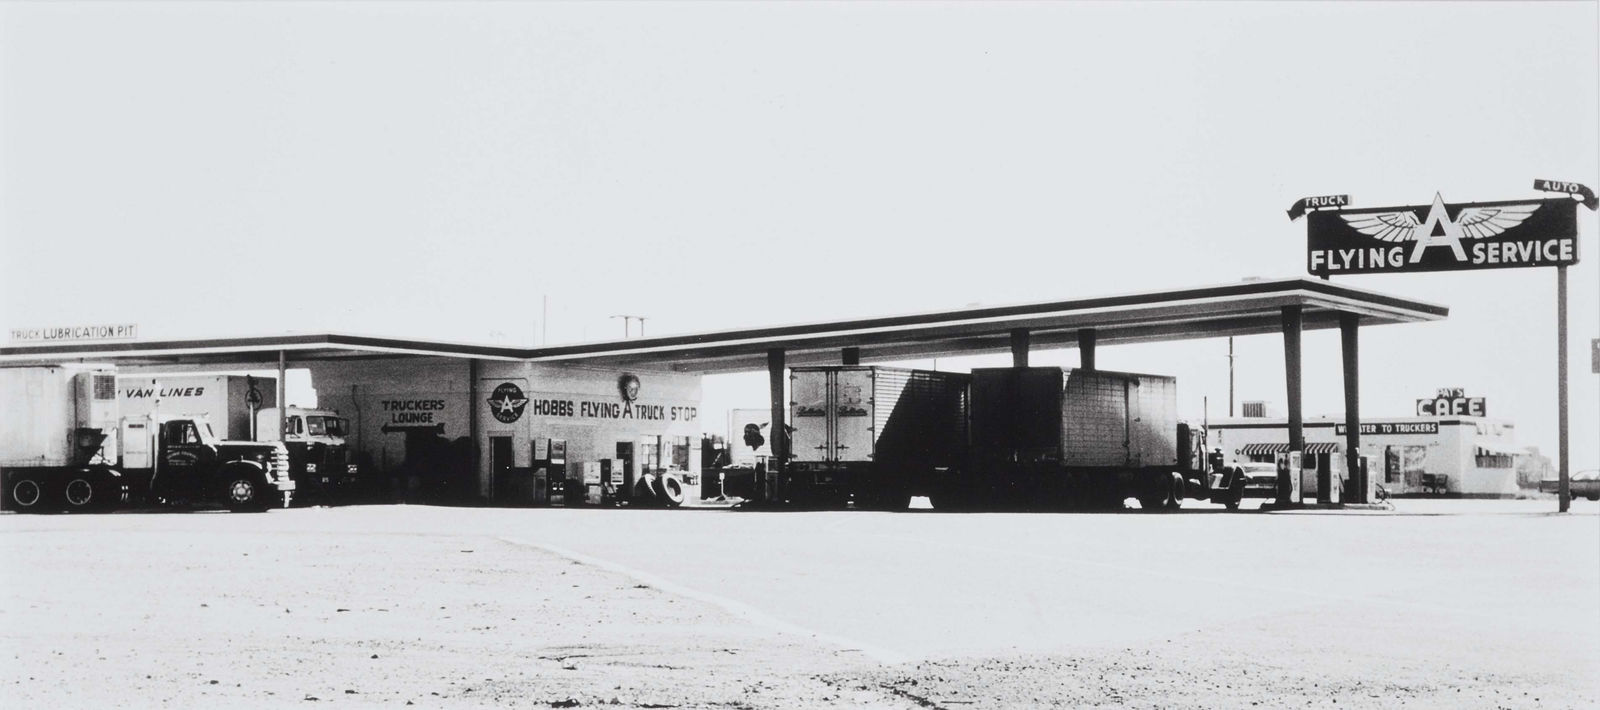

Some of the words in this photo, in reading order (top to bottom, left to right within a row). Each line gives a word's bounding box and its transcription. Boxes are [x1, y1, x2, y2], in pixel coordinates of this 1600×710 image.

[1543, 180, 1579, 193] AUTO
[1305, 195, 1345, 207] TRUCK
[1311, 247, 1404, 271] FLYING
[1408, 190, 1468, 263] A
[1472, 238, 1573, 265] SERVICE
[43, 326, 114, 339] LUBRICATION
[117, 325, 134, 337] PIT
[126, 389, 154, 398] VAN
[160, 387, 204, 397] LINES
[382, 400, 445, 411] TRUCKERS
[500, 395, 514, 413] A
[534, 399, 574, 417] HOBBS
[581, 401, 620, 419] FLYING
[623, 401, 633, 419] A
[636, 405, 665, 420] TRUCK
[671, 407, 697, 422] STOP
[1418, 398, 1483, 416] CAFE
[392, 413, 434, 423] LOUNGE
[1382, 424, 1392, 433] TO
[1395, 423, 1436, 433] TRUCKERS
